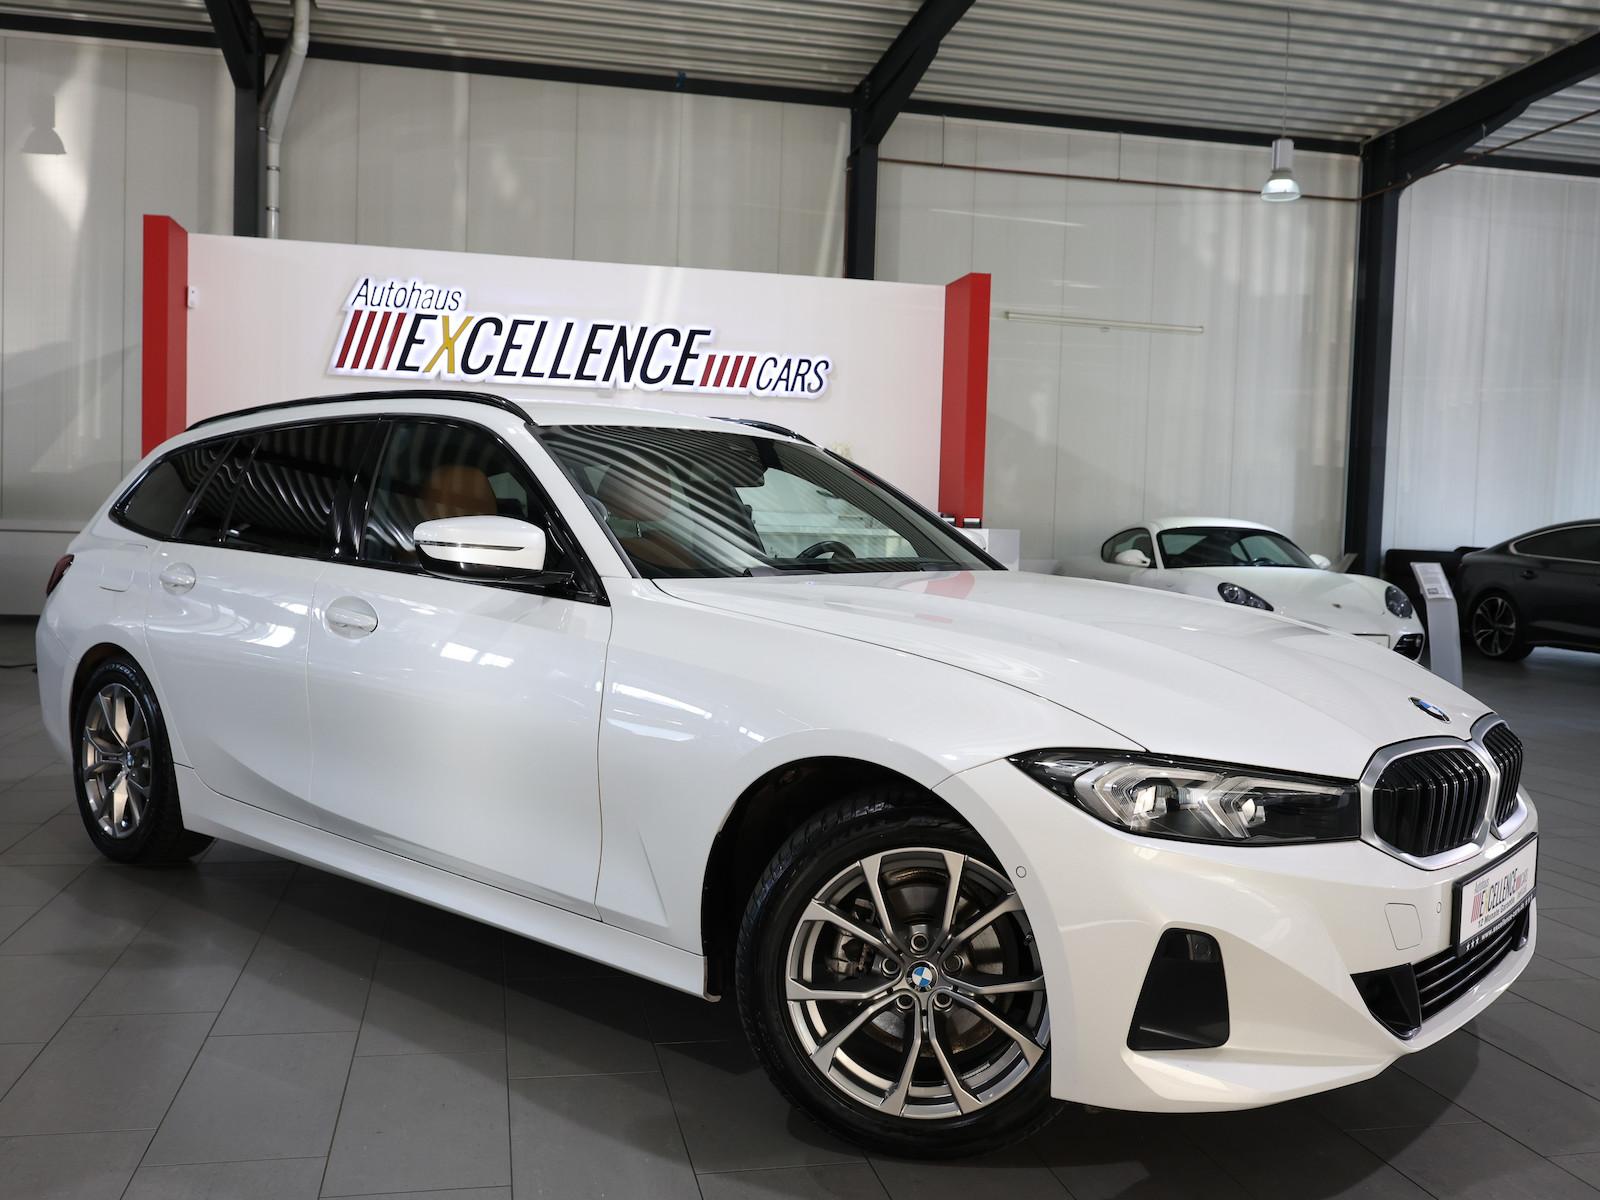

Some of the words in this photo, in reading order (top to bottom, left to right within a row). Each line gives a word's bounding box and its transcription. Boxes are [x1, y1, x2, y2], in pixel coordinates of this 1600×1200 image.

[351, 278, 462, 311] Autohaus
[395, 313, 712, 386] EXCELLENCE
[756, 356, 830, 394] CARS
